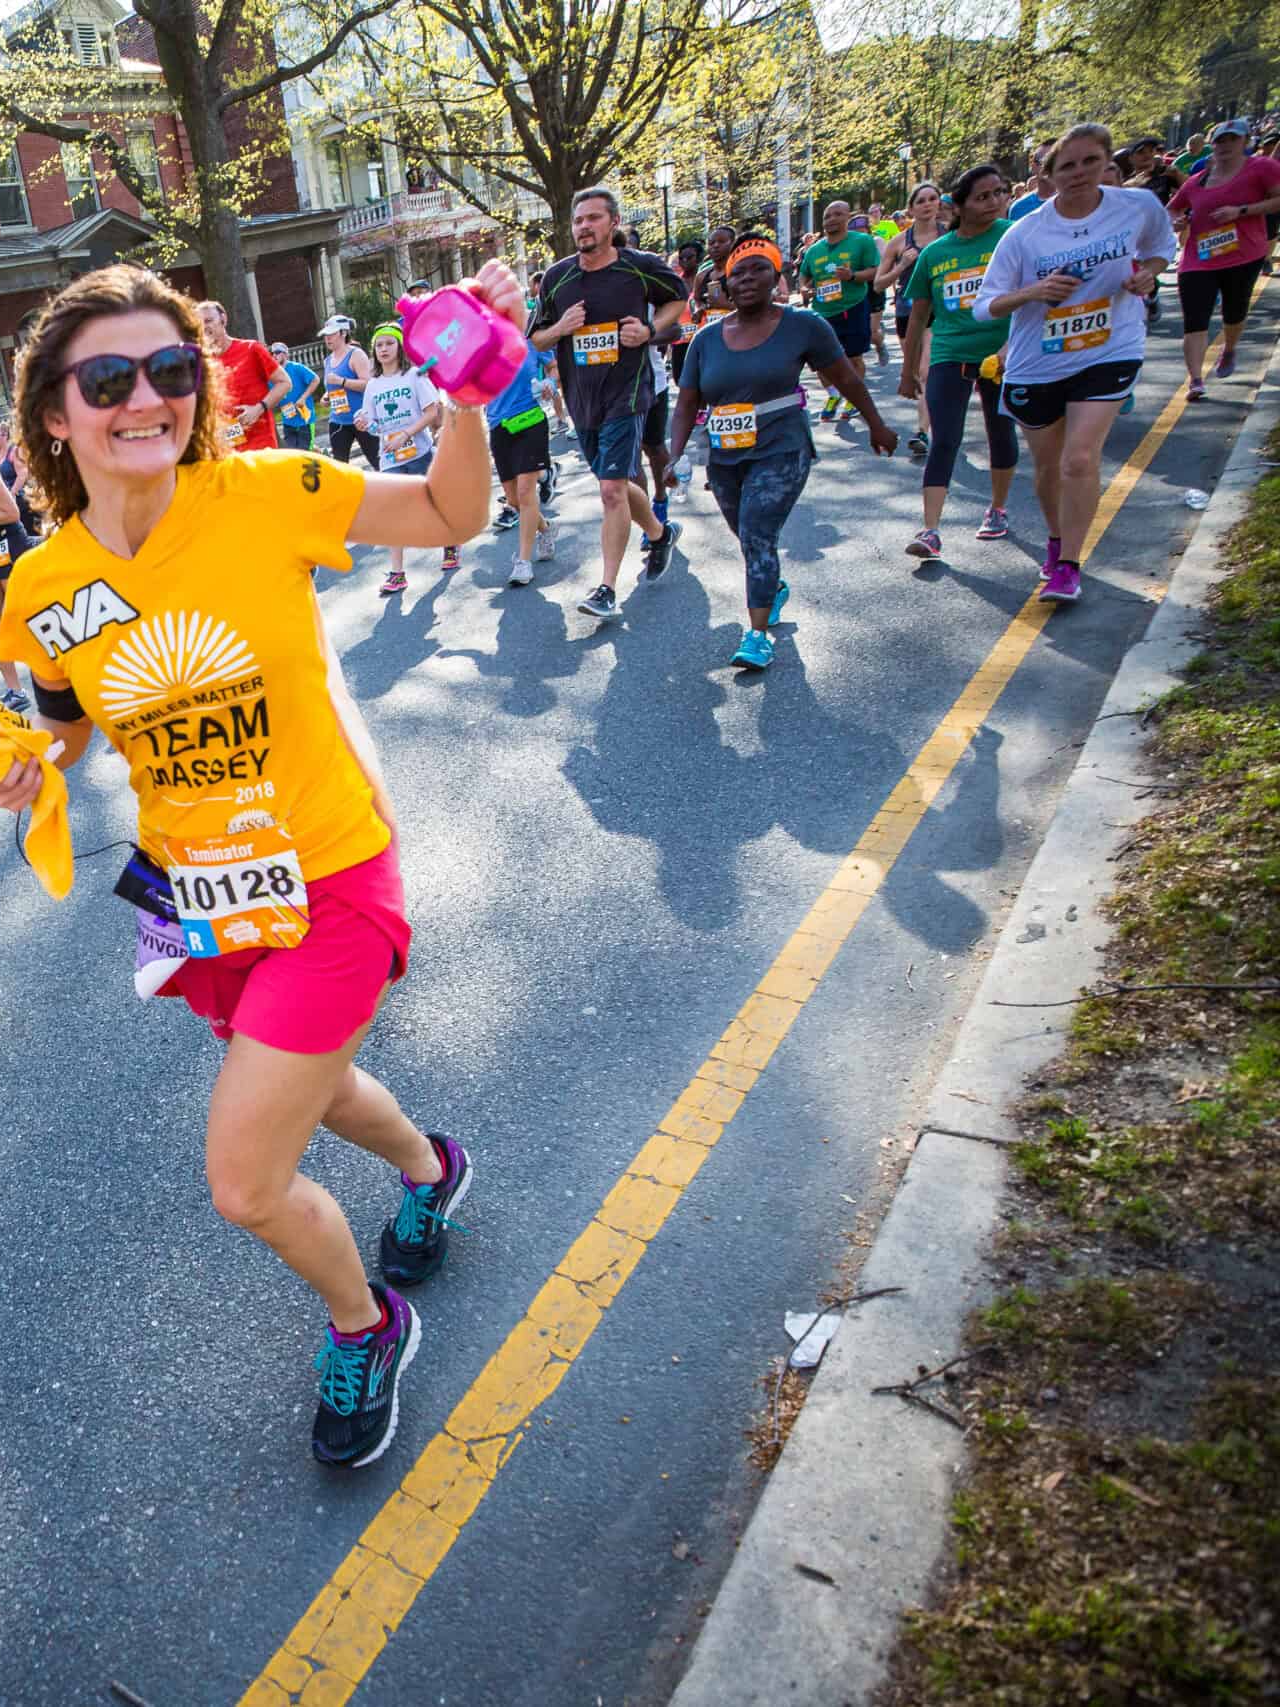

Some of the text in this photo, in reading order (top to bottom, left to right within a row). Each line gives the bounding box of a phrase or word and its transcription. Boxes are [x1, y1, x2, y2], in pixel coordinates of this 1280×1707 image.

[1036, 245, 1130, 280] SOTBALL
[576, 333, 615, 350] 15934
[1048, 312, 1108, 337] 11870
[710, 415, 753, 432] 12392
[26, 578, 140, 660] RVA
[138, 698, 192, 726] MILES
[193, 676, 265, 704] MATTER
[130, 697, 270, 757] TEAM
[147, 748, 270, 790] MASSEY
[235, 781, 275, 804] 2018
[184, 843, 254, 863] Taminator
[174, 865, 295, 912] 10128
